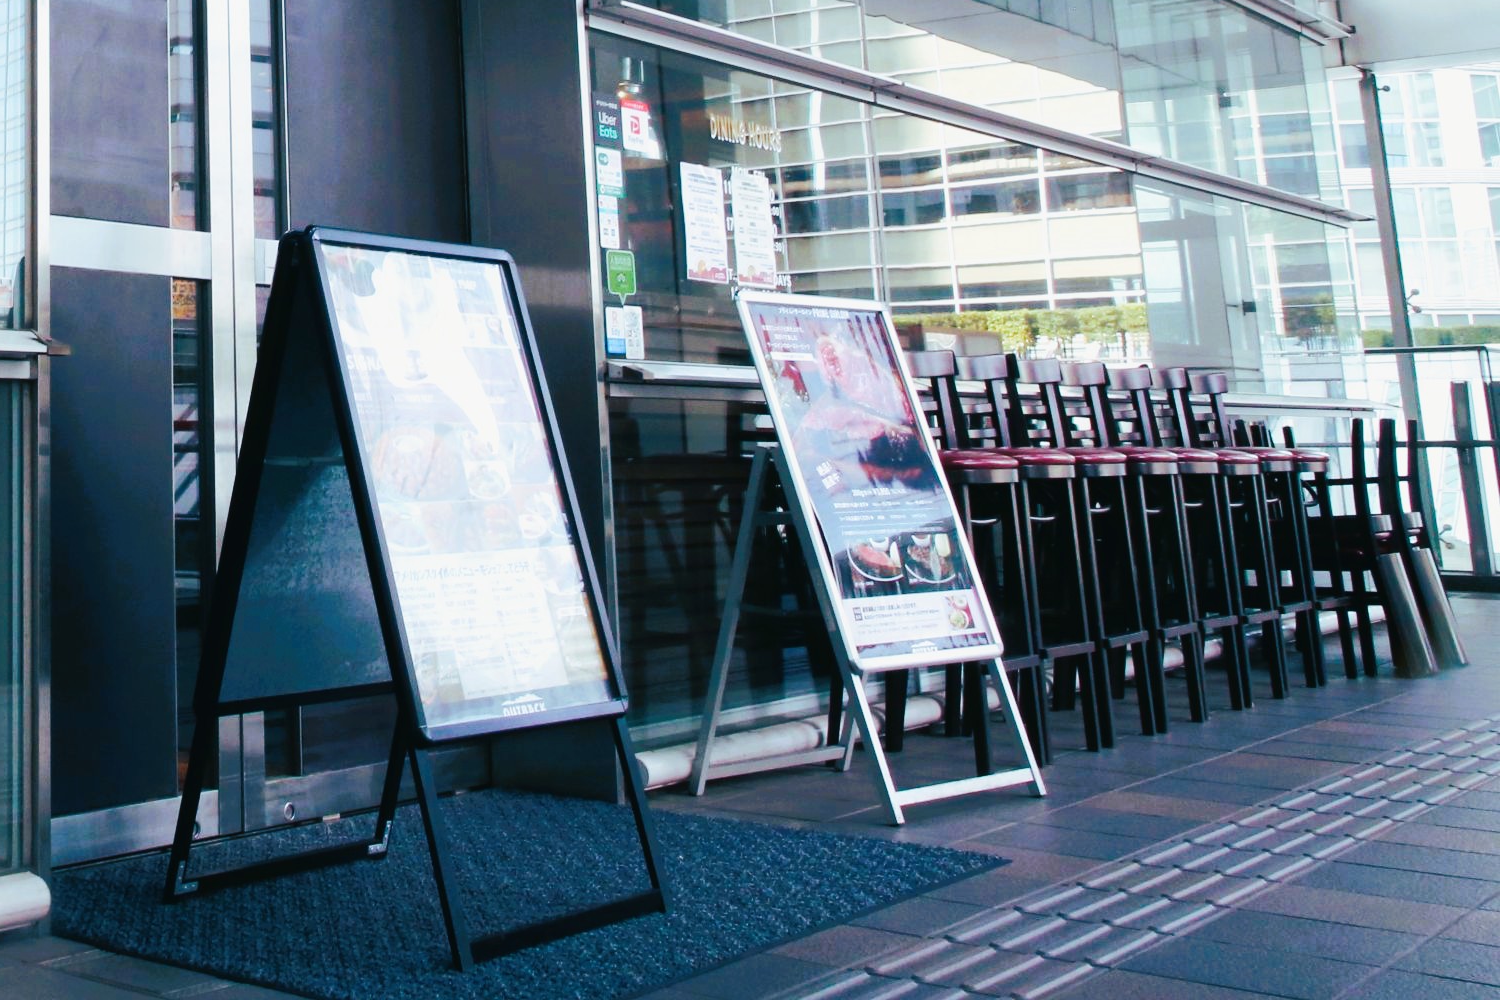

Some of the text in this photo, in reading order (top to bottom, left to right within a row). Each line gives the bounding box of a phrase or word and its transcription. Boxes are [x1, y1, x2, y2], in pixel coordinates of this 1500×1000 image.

[598, 112, 617, 127] Uber
[599, 125, 618, 140] Eats
[710, 113, 782, 153] DINING HOURS
